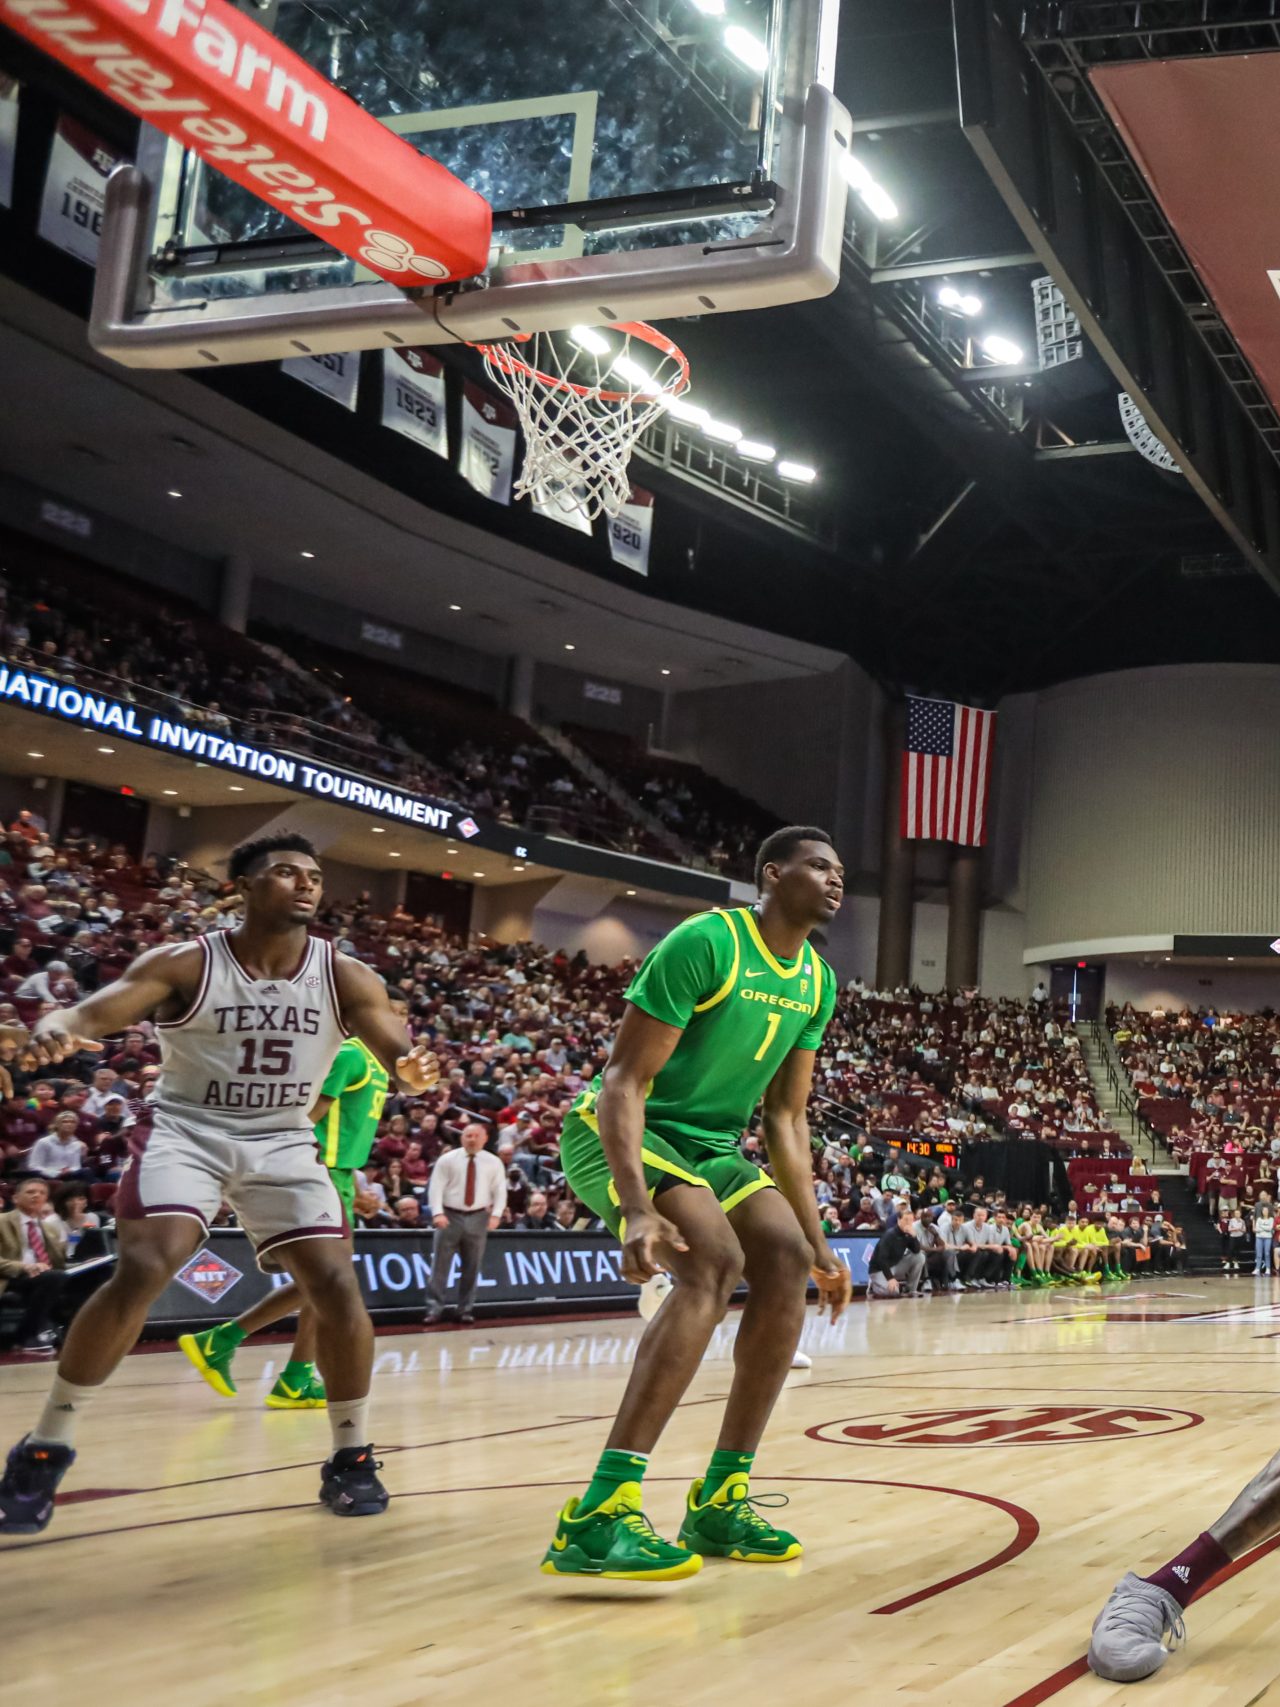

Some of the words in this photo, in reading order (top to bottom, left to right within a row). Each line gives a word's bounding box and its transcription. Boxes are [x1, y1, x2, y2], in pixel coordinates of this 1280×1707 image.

[155, 0, 329, 142] Farm
[182, 117, 371, 227] State
[612, 522, 641, 551] 920
[151, 718, 296, 783] INVITATION
[302, 767, 453, 830] TOURNAMENT
[213, 1004, 321, 1035] TEXAS
[740, 988, 812, 1015] OREGON
[753, 1012, 782, 1061] 1
[237, 1038, 294, 1076] 15
[203, 1080, 313, 1109] AGGIES
